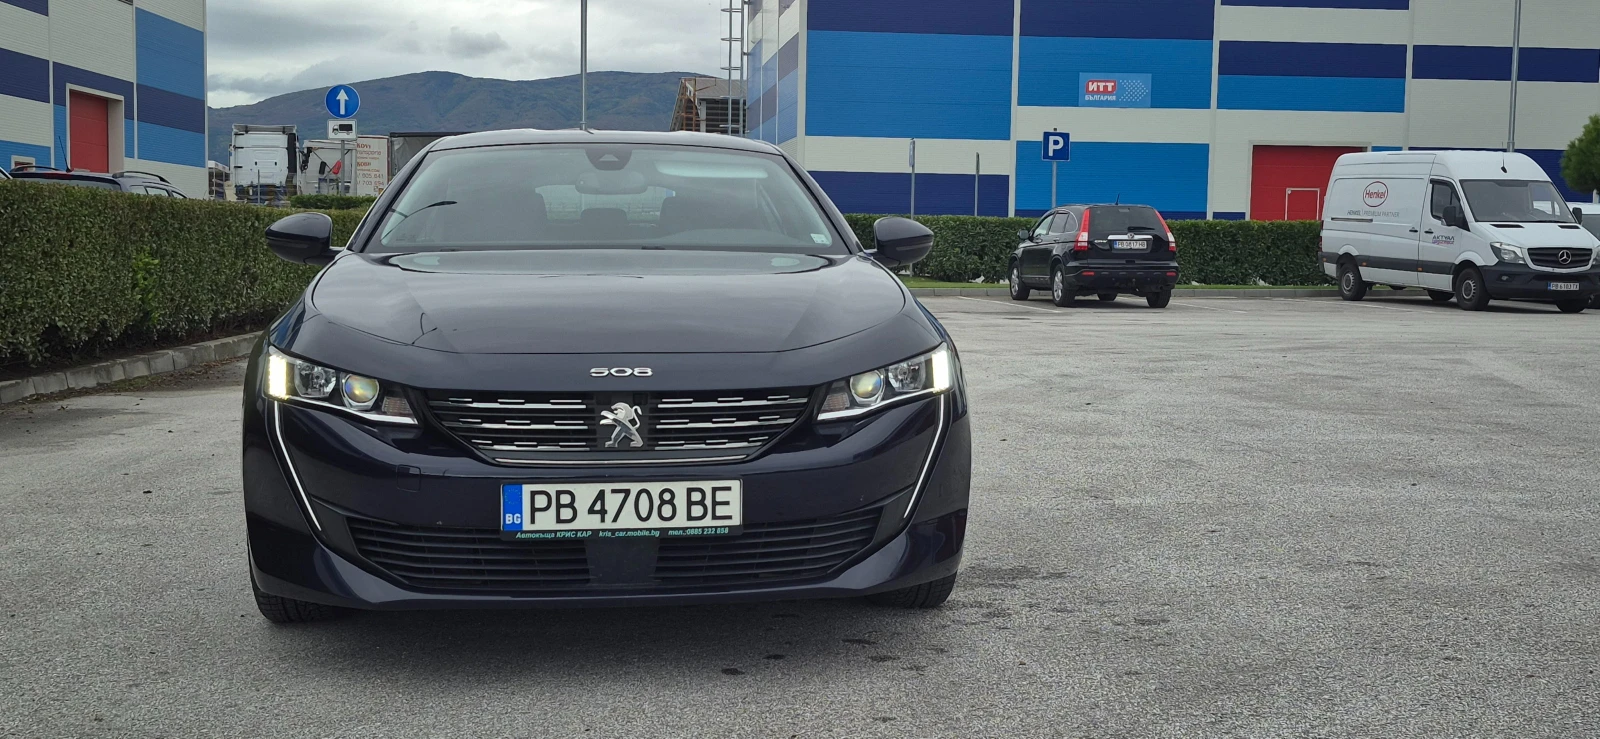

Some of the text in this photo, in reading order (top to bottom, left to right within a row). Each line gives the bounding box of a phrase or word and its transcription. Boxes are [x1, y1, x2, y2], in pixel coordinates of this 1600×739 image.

[1088, 81, 1115, 92] ИТТ
[1048, 135, 1064, 157] P
[1364, 189, 1387, 199] Henkel
[590, 367, 654, 377] 508
[530, 486, 733, 525] PB 4708 BE
[505, 513, 522, 524] BG
[556, 530, 576, 538] КРИС
[577, 530, 593, 538] КАР
[598, 529, 660, 538] kris_car.mobile.bg
[704, 527, 716, 535] 232
